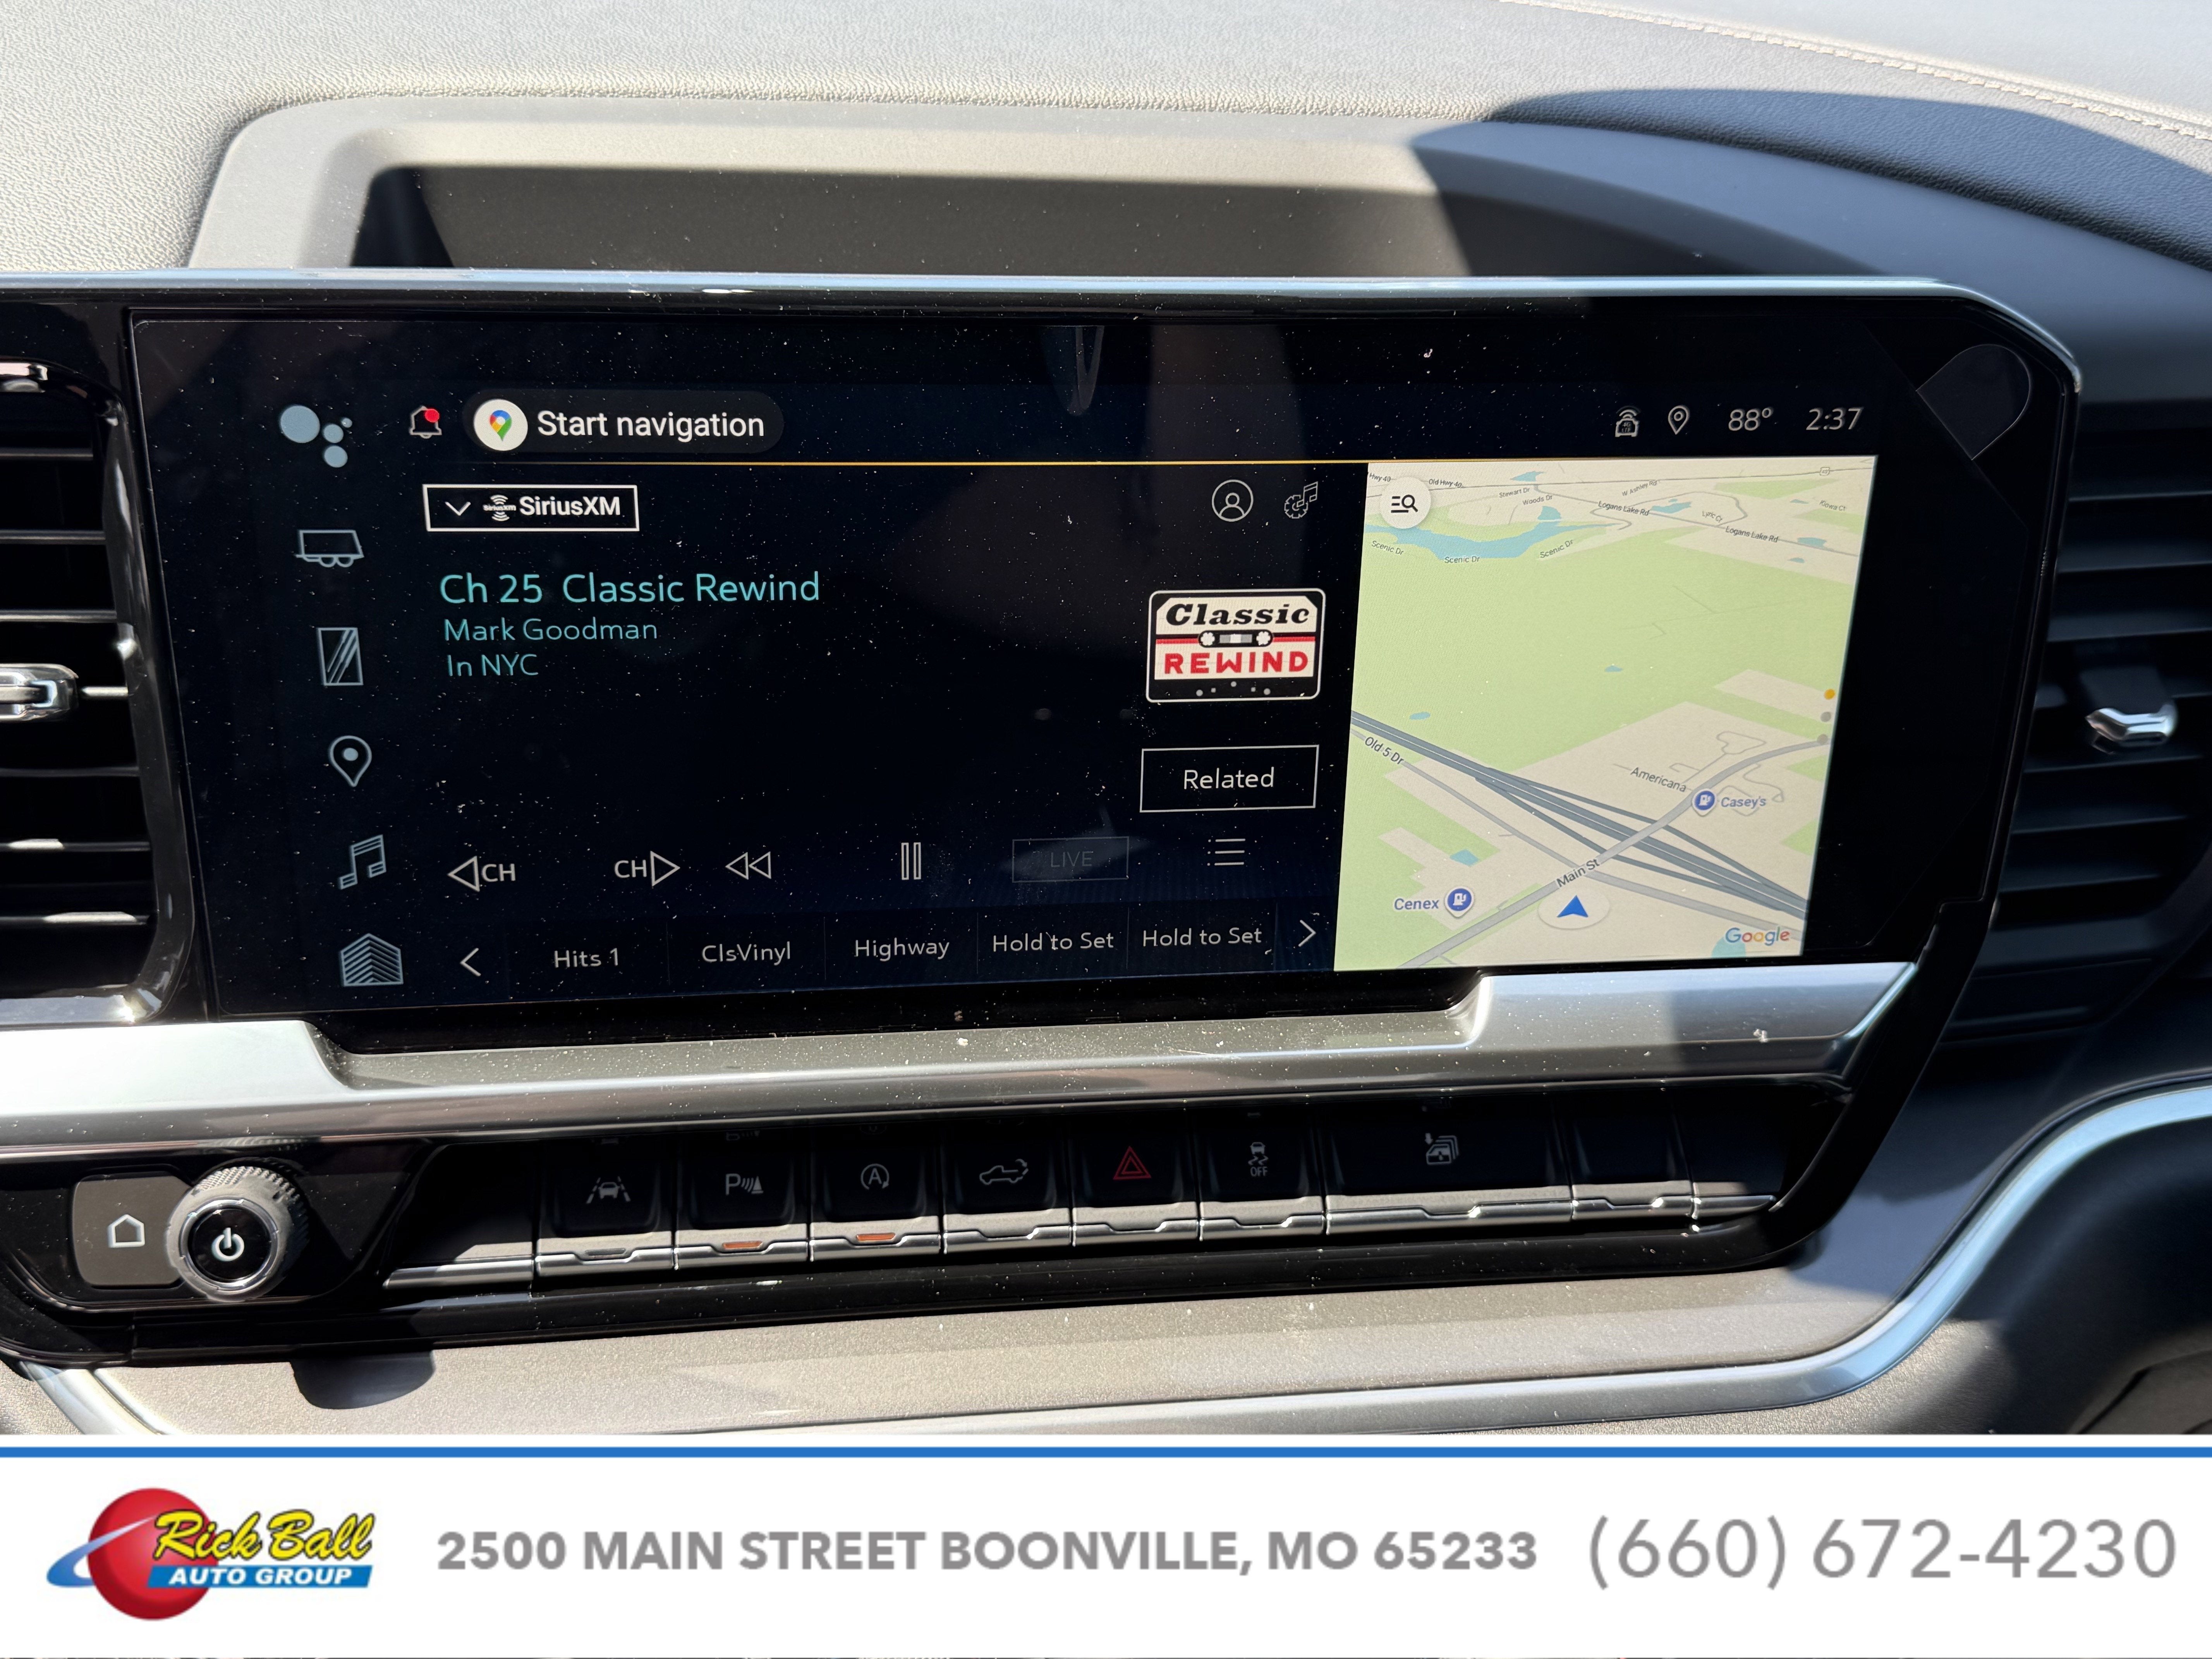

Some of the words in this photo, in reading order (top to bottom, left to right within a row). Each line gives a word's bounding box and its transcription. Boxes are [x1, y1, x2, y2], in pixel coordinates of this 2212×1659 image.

[538, 410, 608, 437] Start
[617, 410, 764, 442] navigation
[1728, 407, 1774, 431] 88°
[1806, 407, 1863, 431] 2:37
[1369, 472, 1382, 482] Hwy
[1499, 488, 1522, 498] Stewart
[1522, 496, 1544, 505] Woods
[519, 496, 620, 516] SiriusXM
[1598, 501, 1622, 510] Logans
[1623, 505, 1638, 515] Lake
[1725, 526, 1750, 537] Logans
[1751, 531, 1768, 541] Lake
[1769, 534, 1778, 543] Rd
[1371, 540, 1394, 553] Scenic
[1540, 544, 1565, 558] Scenic
[1565, 539, 1573, 548] Dr
[440, 572, 488, 603] Ch
[499, 574, 543, 603] 25
[562, 571, 685, 603] Classic
[696, 570, 820, 602] Rewind
[1166, 603, 1310, 626] Classic
[445, 618, 515, 641] Mark
[523, 617, 658, 641] Goodman
[447, 654, 473, 677] In
[481, 653, 539, 677] NYC
[1164, 651, 1309, 675] REWIND
[1364, 736, 1383, 752] Old
[1382, 747, 1392, 757] 5
[1391, 752, 1405, 766] Dr
[1183, 766, 1275, 790] Related
[1630, 766, 1686, 792] Americana
[1721, 796, 1766, 808] Casey's
[614, 860, 647, 878] CH
[1050, 850, 1094, 868] LIVE
[481, 863, 516, 882] CH
[1556, 866, 1586, 888] Main
[1586, 858, 1600, 871] St
[1394, 898, 1439, 910] Cenex
[993, 933, 1043, 952] Hold
[1051, 934, 1072, 950] to
[1080, 932, 1114, 949] Set
[1143, 928, 1192, 947] Hold
[1199, 929, 1221, 945] to
[1228, 927, 1262, 945] Set
[1725, 927, 1790, 946] Google
[554, 950, 602, 968] Hits
[610, 948, 618, 966] 1
[702, 941, 791, 966] ClsVinyl
[855, 937, 950, 962] Highway
[1250, 1166, 1268, 1177] OFF
